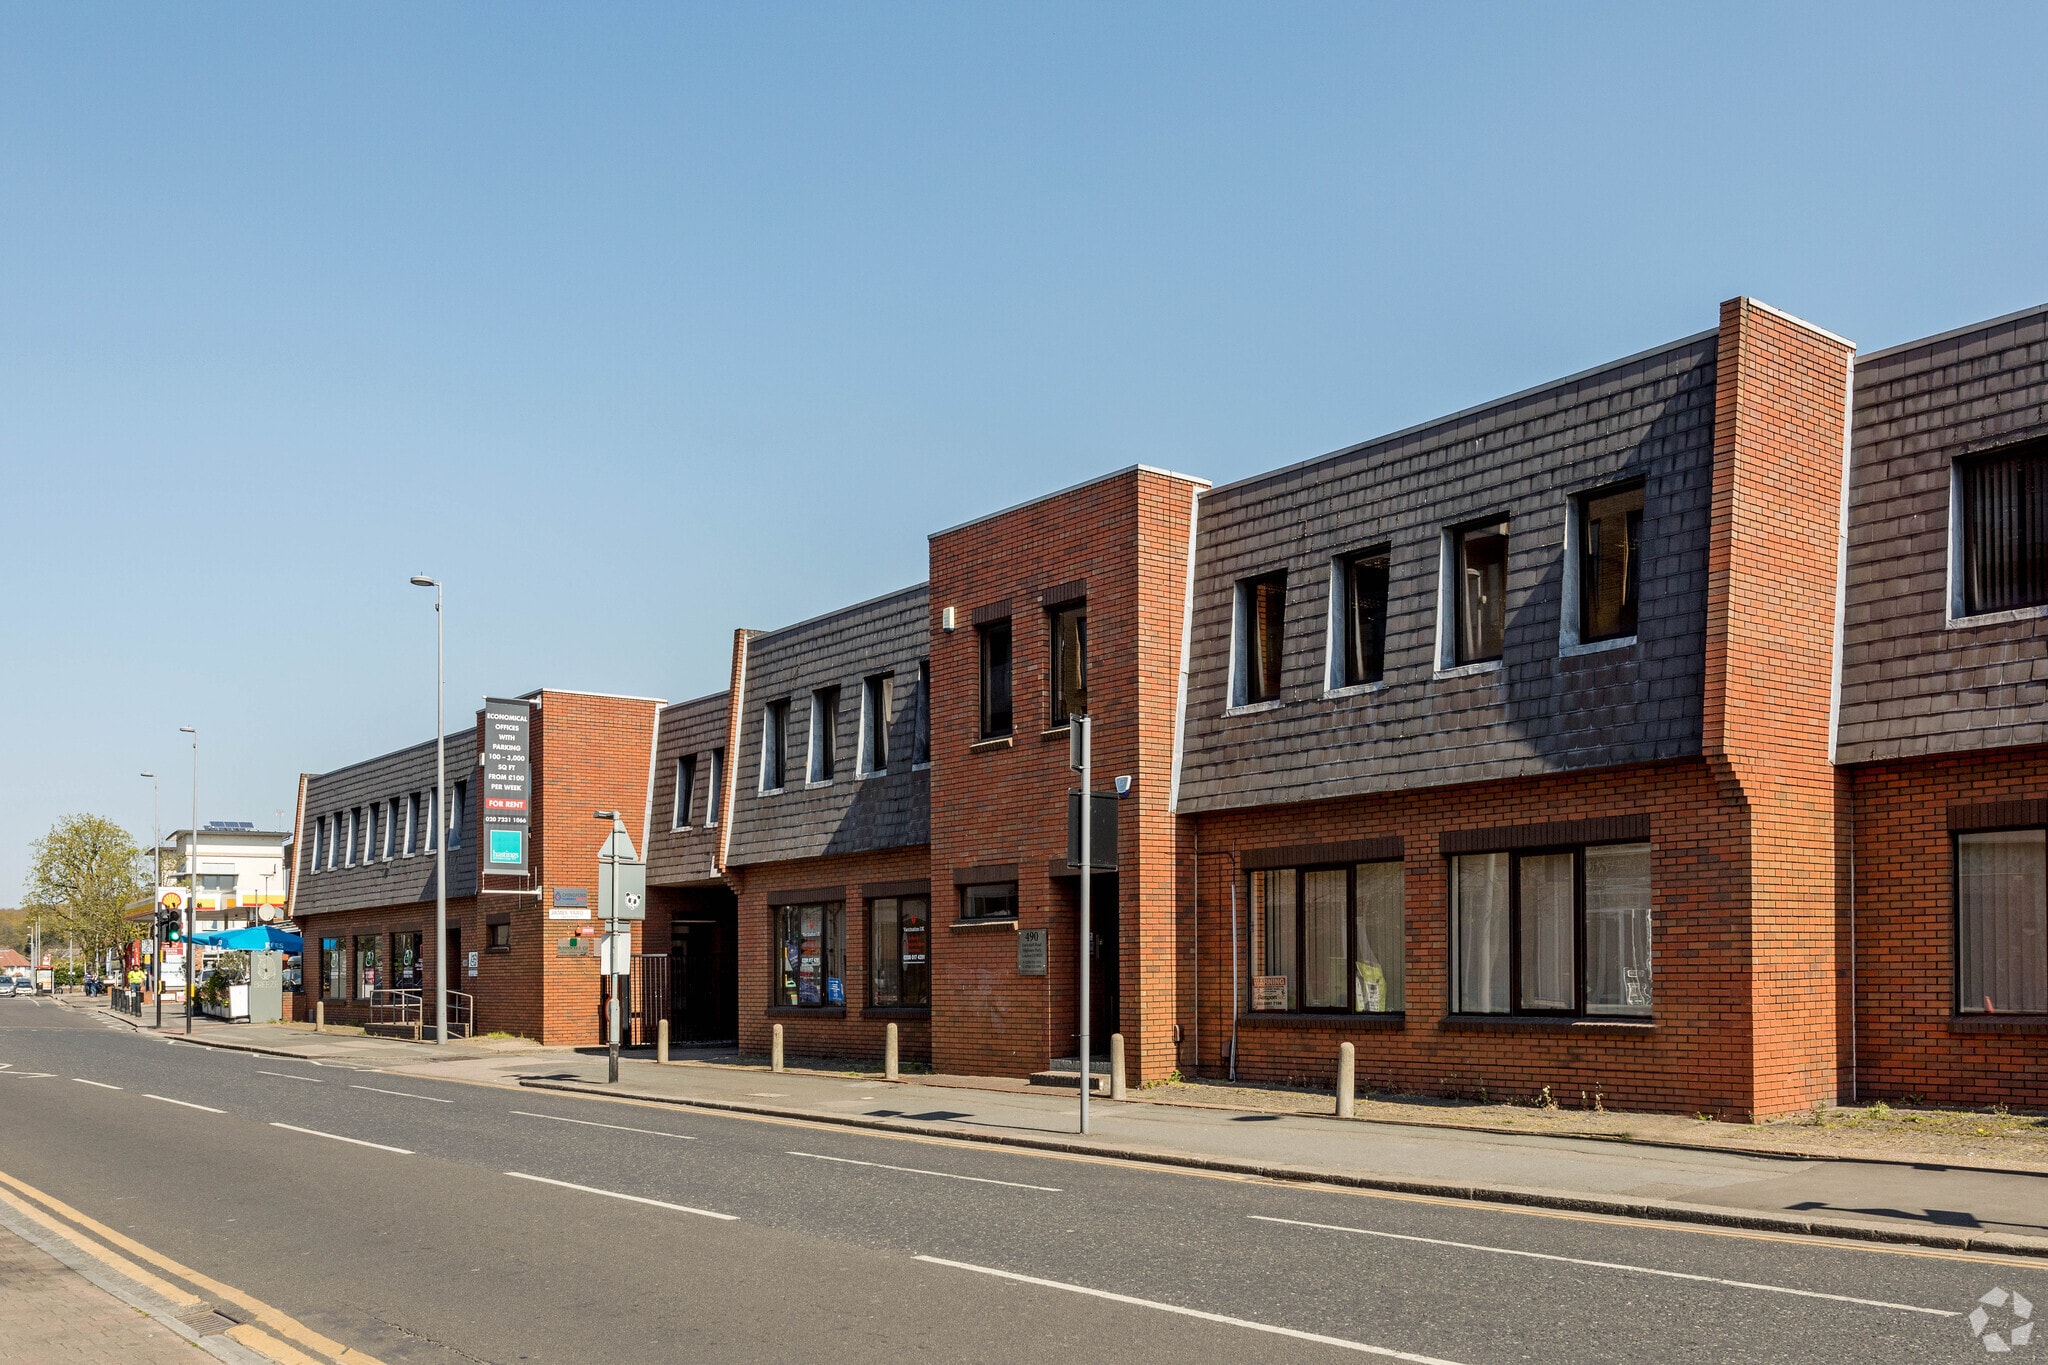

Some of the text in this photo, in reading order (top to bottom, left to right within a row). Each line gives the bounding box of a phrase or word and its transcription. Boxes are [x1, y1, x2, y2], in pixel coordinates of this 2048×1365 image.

[487, 712, 528, 722] ECONOMICAL
[495, 723, 519, 731] OFFICES
[492, 743, 521, 752] PARKING
[488, 773, 525, 782] FROM £100
[491, 783, 522, 792] PER WEEK
[489, 799, 524, 809] FOR RENT
[493, 849, 519, 861] hastings
[1025, 931, 1039, 941] 490
[1253, 978, 1285, 986] WARNING
